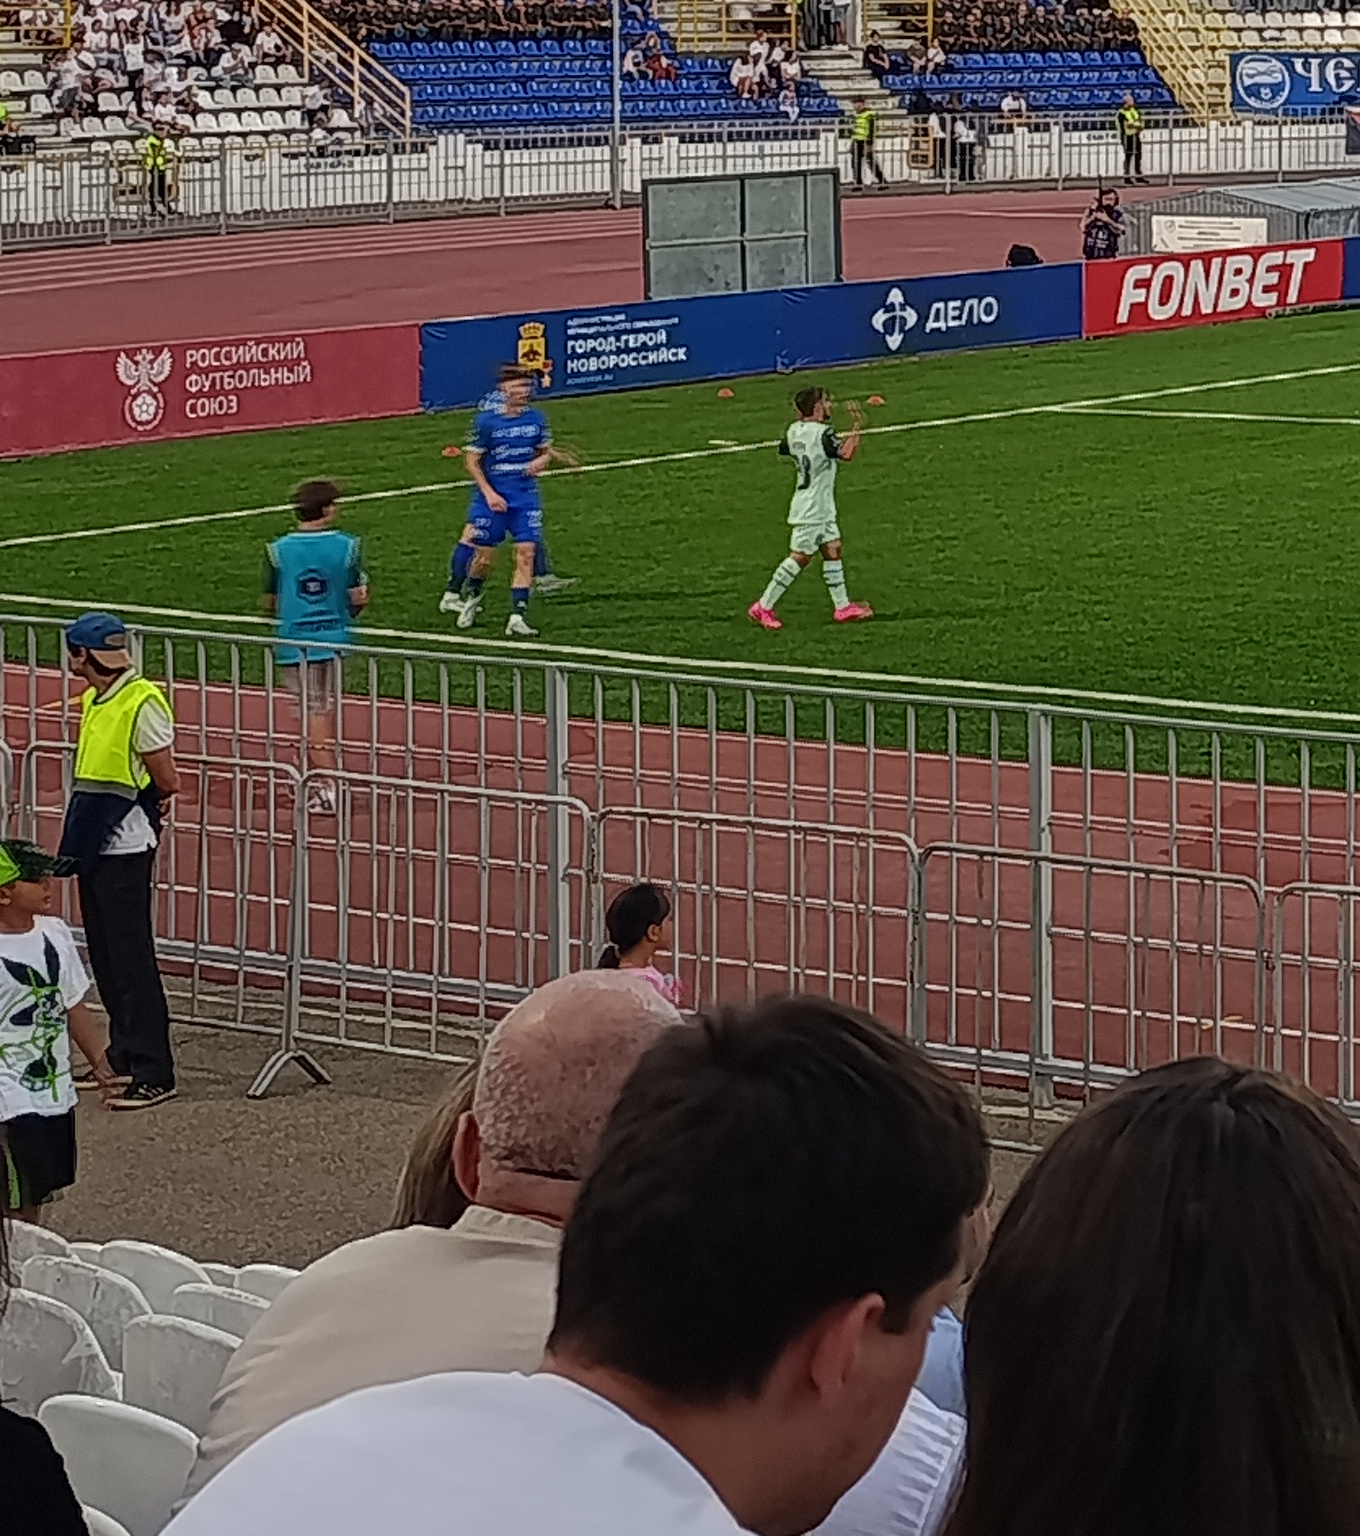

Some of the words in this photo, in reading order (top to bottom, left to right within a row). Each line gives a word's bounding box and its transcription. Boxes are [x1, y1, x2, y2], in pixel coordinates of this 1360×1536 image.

[1117, 247, 1316, 325] FONBET
[925, 296, 998, 333] ДЕЛО
[185, 337, 304, 369] РОССИЙСКИЙ
[567, 329, 667, 354] ГОРОД-ГЕРОЙ
[567, 347, 687, 374] НОВОРОССИЙСК
[185, 361, 312, 393] ФУТБОЛЬНЫЙ
[185, 395, 238, 418] СОЮЗ
